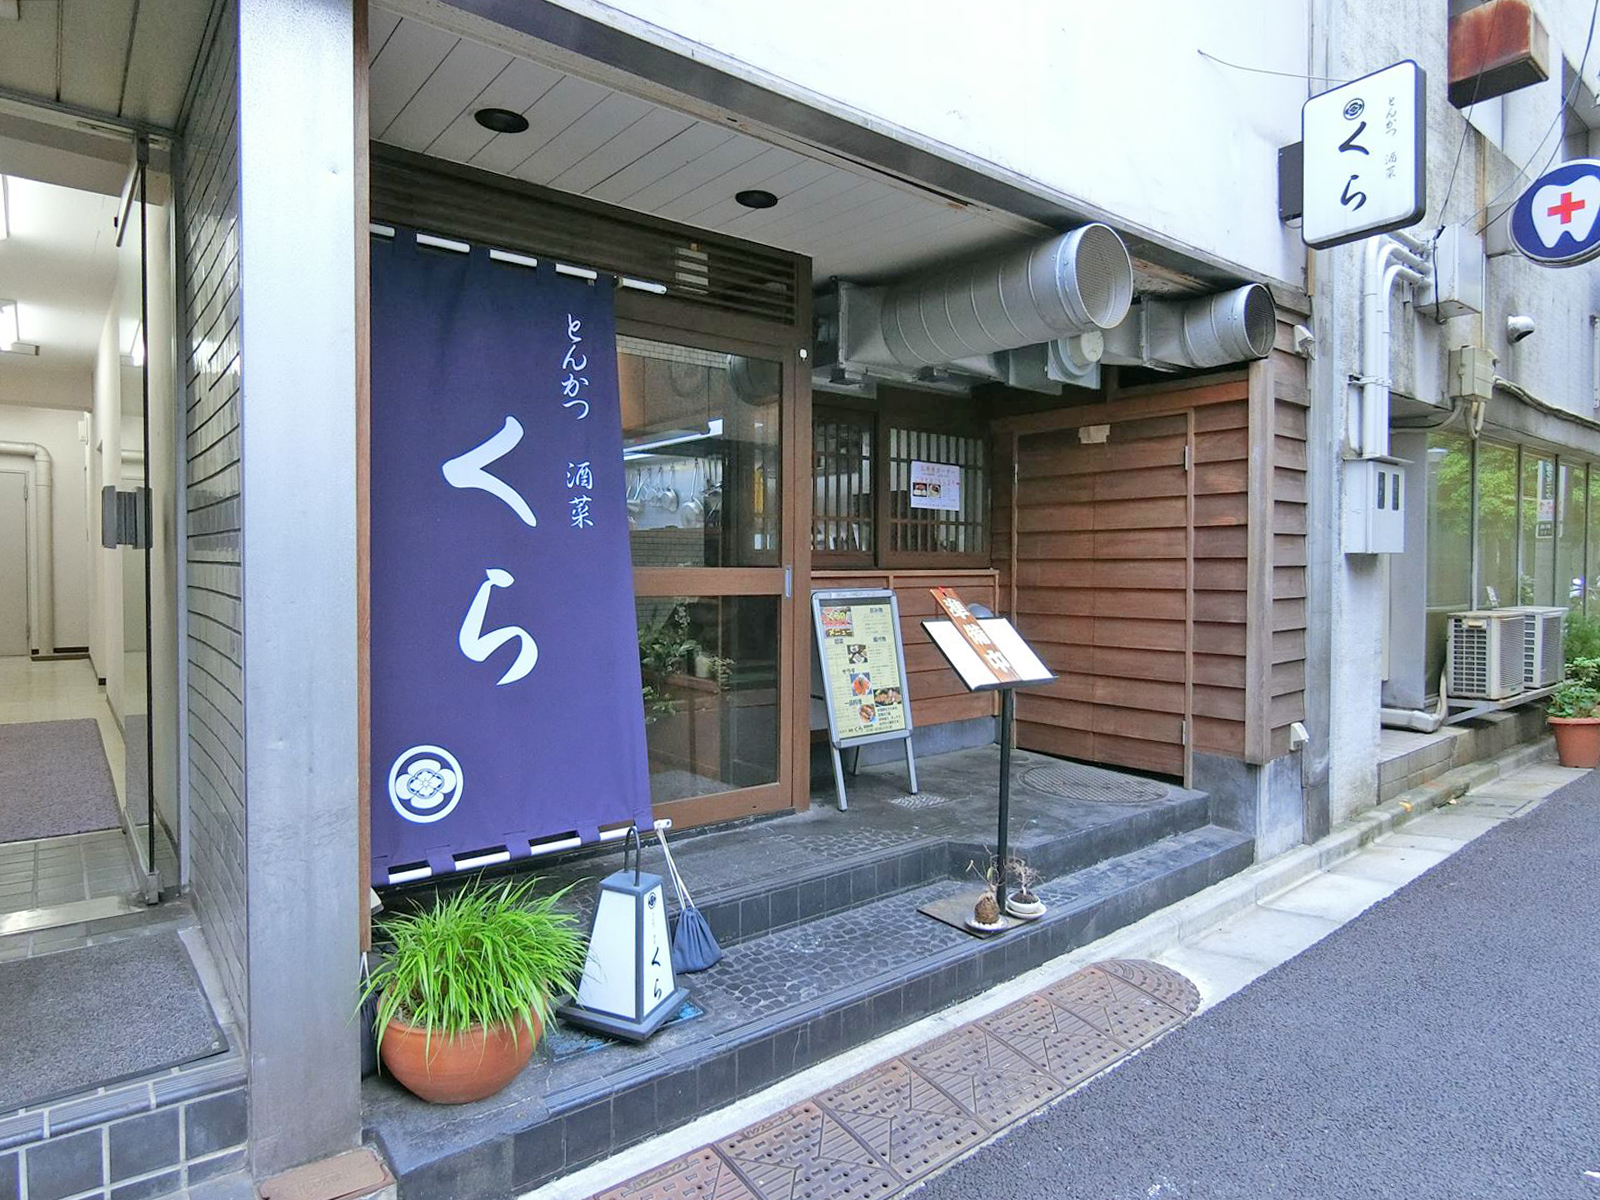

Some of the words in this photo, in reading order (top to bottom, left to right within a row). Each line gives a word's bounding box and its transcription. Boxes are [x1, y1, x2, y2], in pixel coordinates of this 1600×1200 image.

[1385, 97, 1397, 137] とんかつ
[1338, 121, 1370, 212] くら
[561, 313, 590, 420] とんかつ
[565, 461, 594, 529] 酒菜
[441, 414, 539, 685] くら
[651, 947, 662, 1000] くら
